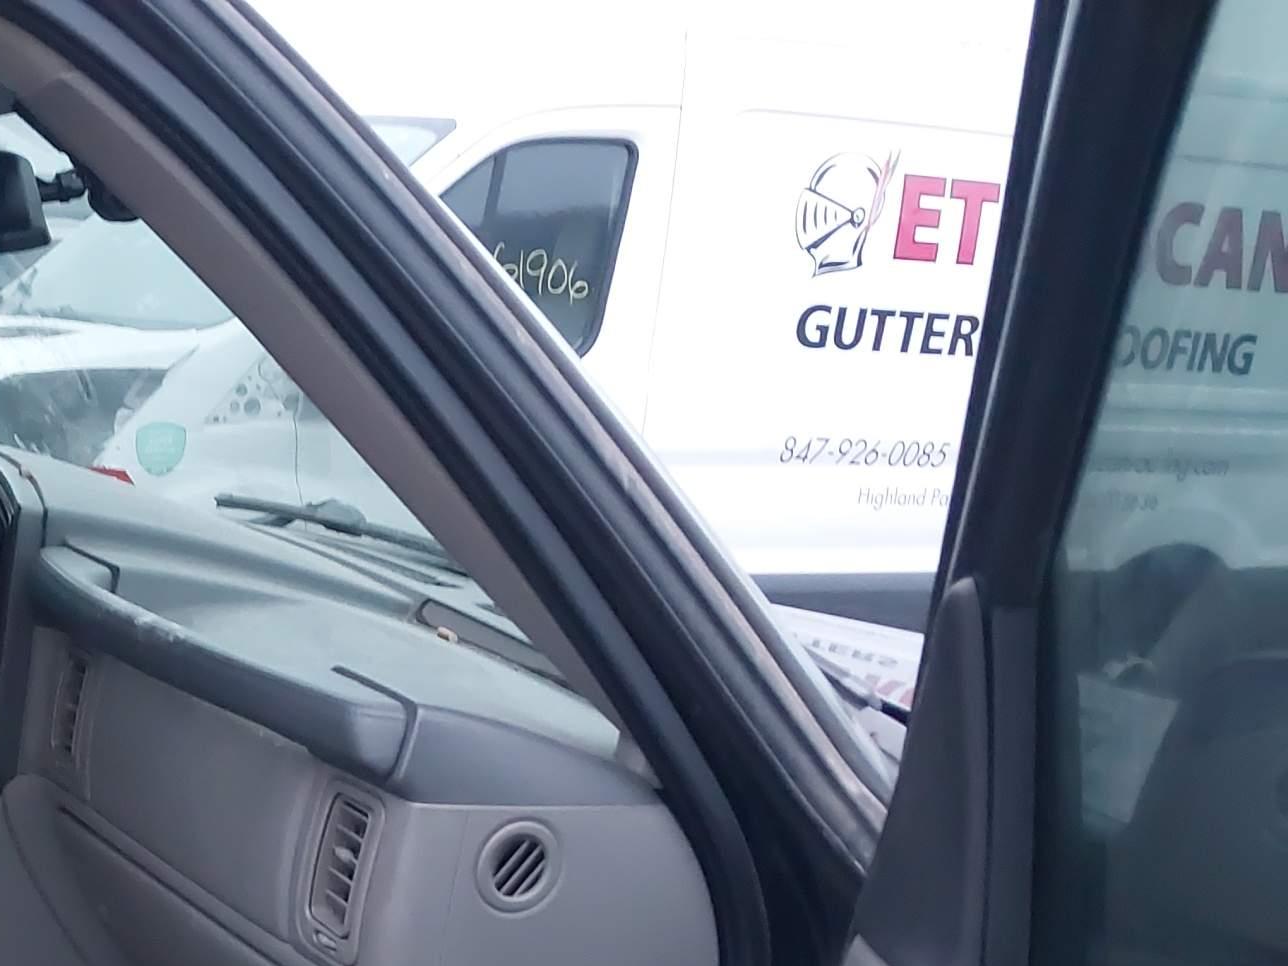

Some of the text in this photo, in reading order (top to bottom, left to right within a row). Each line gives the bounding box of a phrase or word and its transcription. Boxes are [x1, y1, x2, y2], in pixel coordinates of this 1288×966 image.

[893, 173, 1001, 265] ET
[1112, 325, 1258, 376] OOFING
[779, 436, 951, 467] 847-926-0085
[857, 487, 950, 511] Highland Pa
